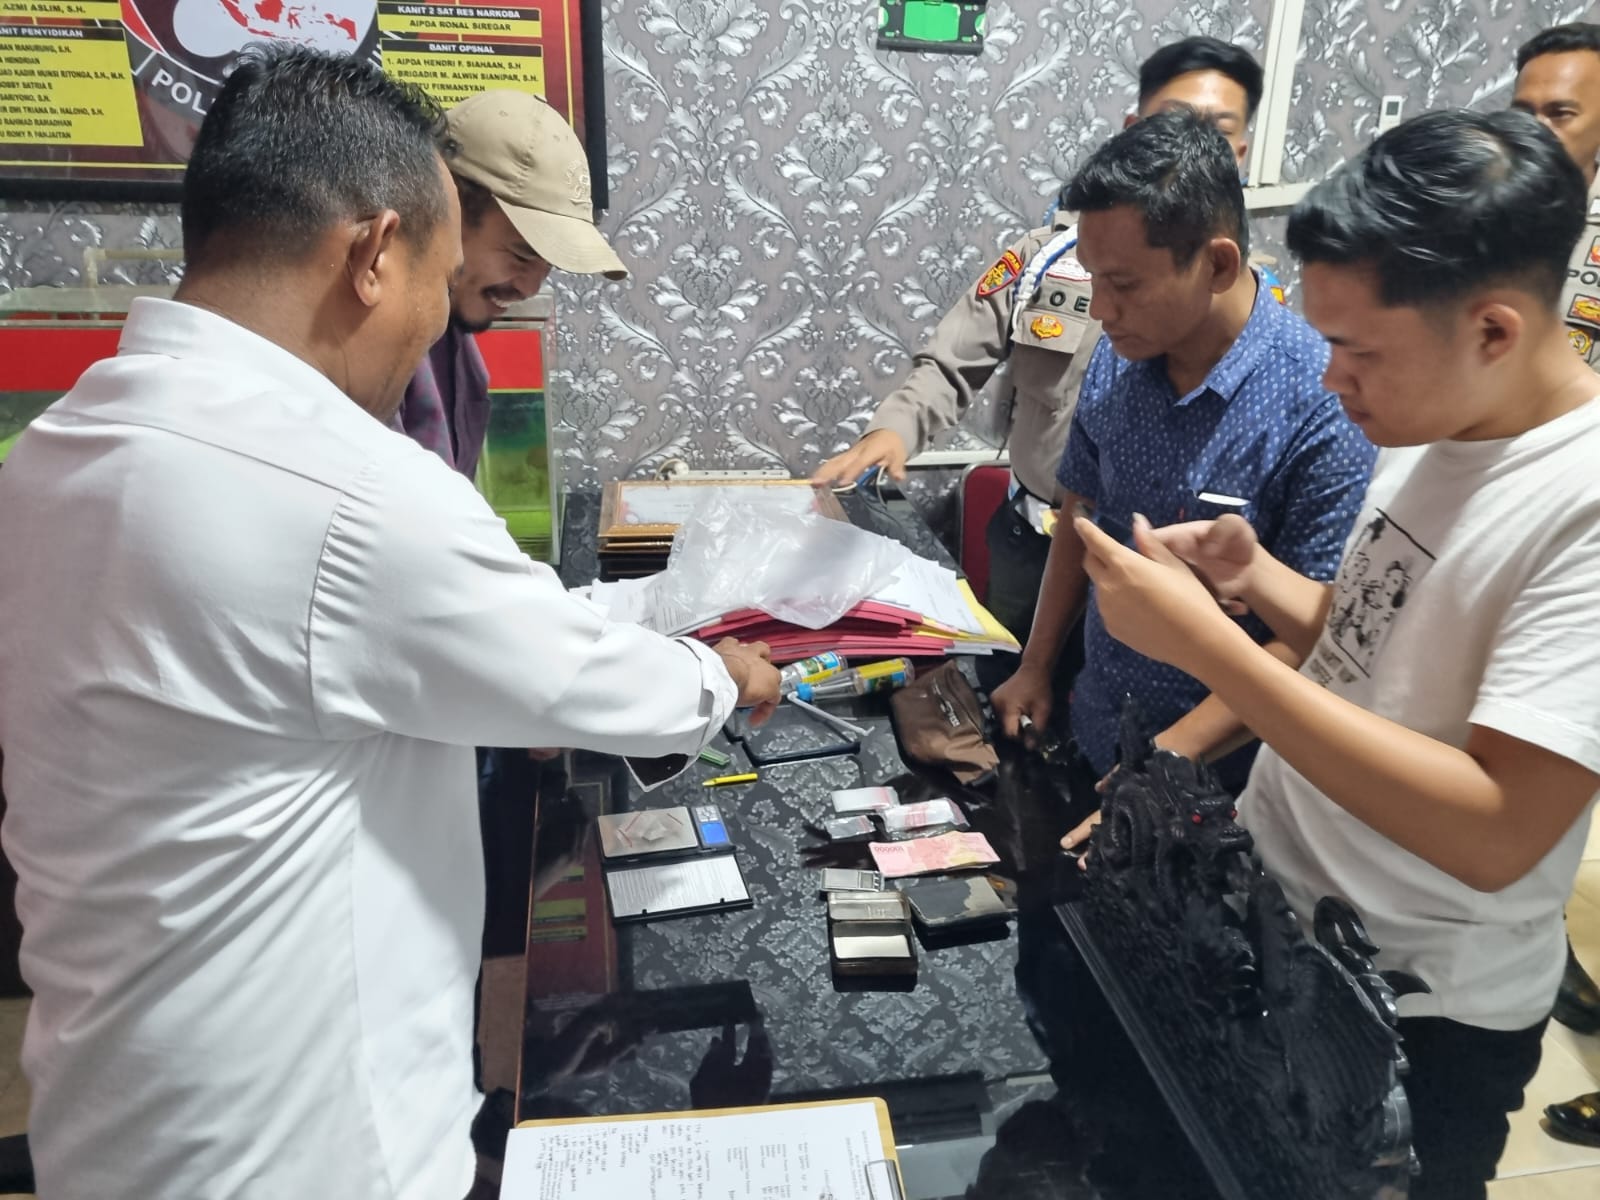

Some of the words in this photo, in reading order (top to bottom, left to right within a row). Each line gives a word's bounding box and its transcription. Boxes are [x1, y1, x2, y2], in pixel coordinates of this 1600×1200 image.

[3, 3, 27, 11] AZMI
[397, 5, 426, 15] KANIT
[429, 6, 435, 15] 2
[437, 7, 453, 16] SAT
[456, 8, 474, 17] RES
[476, 9, 520, 19] NARKOBA
[409, 20, 437, 28] AIPDA
[439, 21, 469, 30] RONAL
[472, 22, 511, 31] SIREGAR
[21, 28, 84, 38] PENYIDIKAN
[428, 43, 456, 52] BANIT
[458, 44, 495, 54] OPSNAL
[396, 58, 422, 66] AIPDA
[424, 59, 456, 68] HENDRI
[397, 71, 438, 79] BRIGADIR
[451, 73, 478, 81] ALWIN
[151, 68, 217, 116] POL
[431, 83, 486, 92] FIRMANSYAH
[1566, 268, 1600, 288] PO
